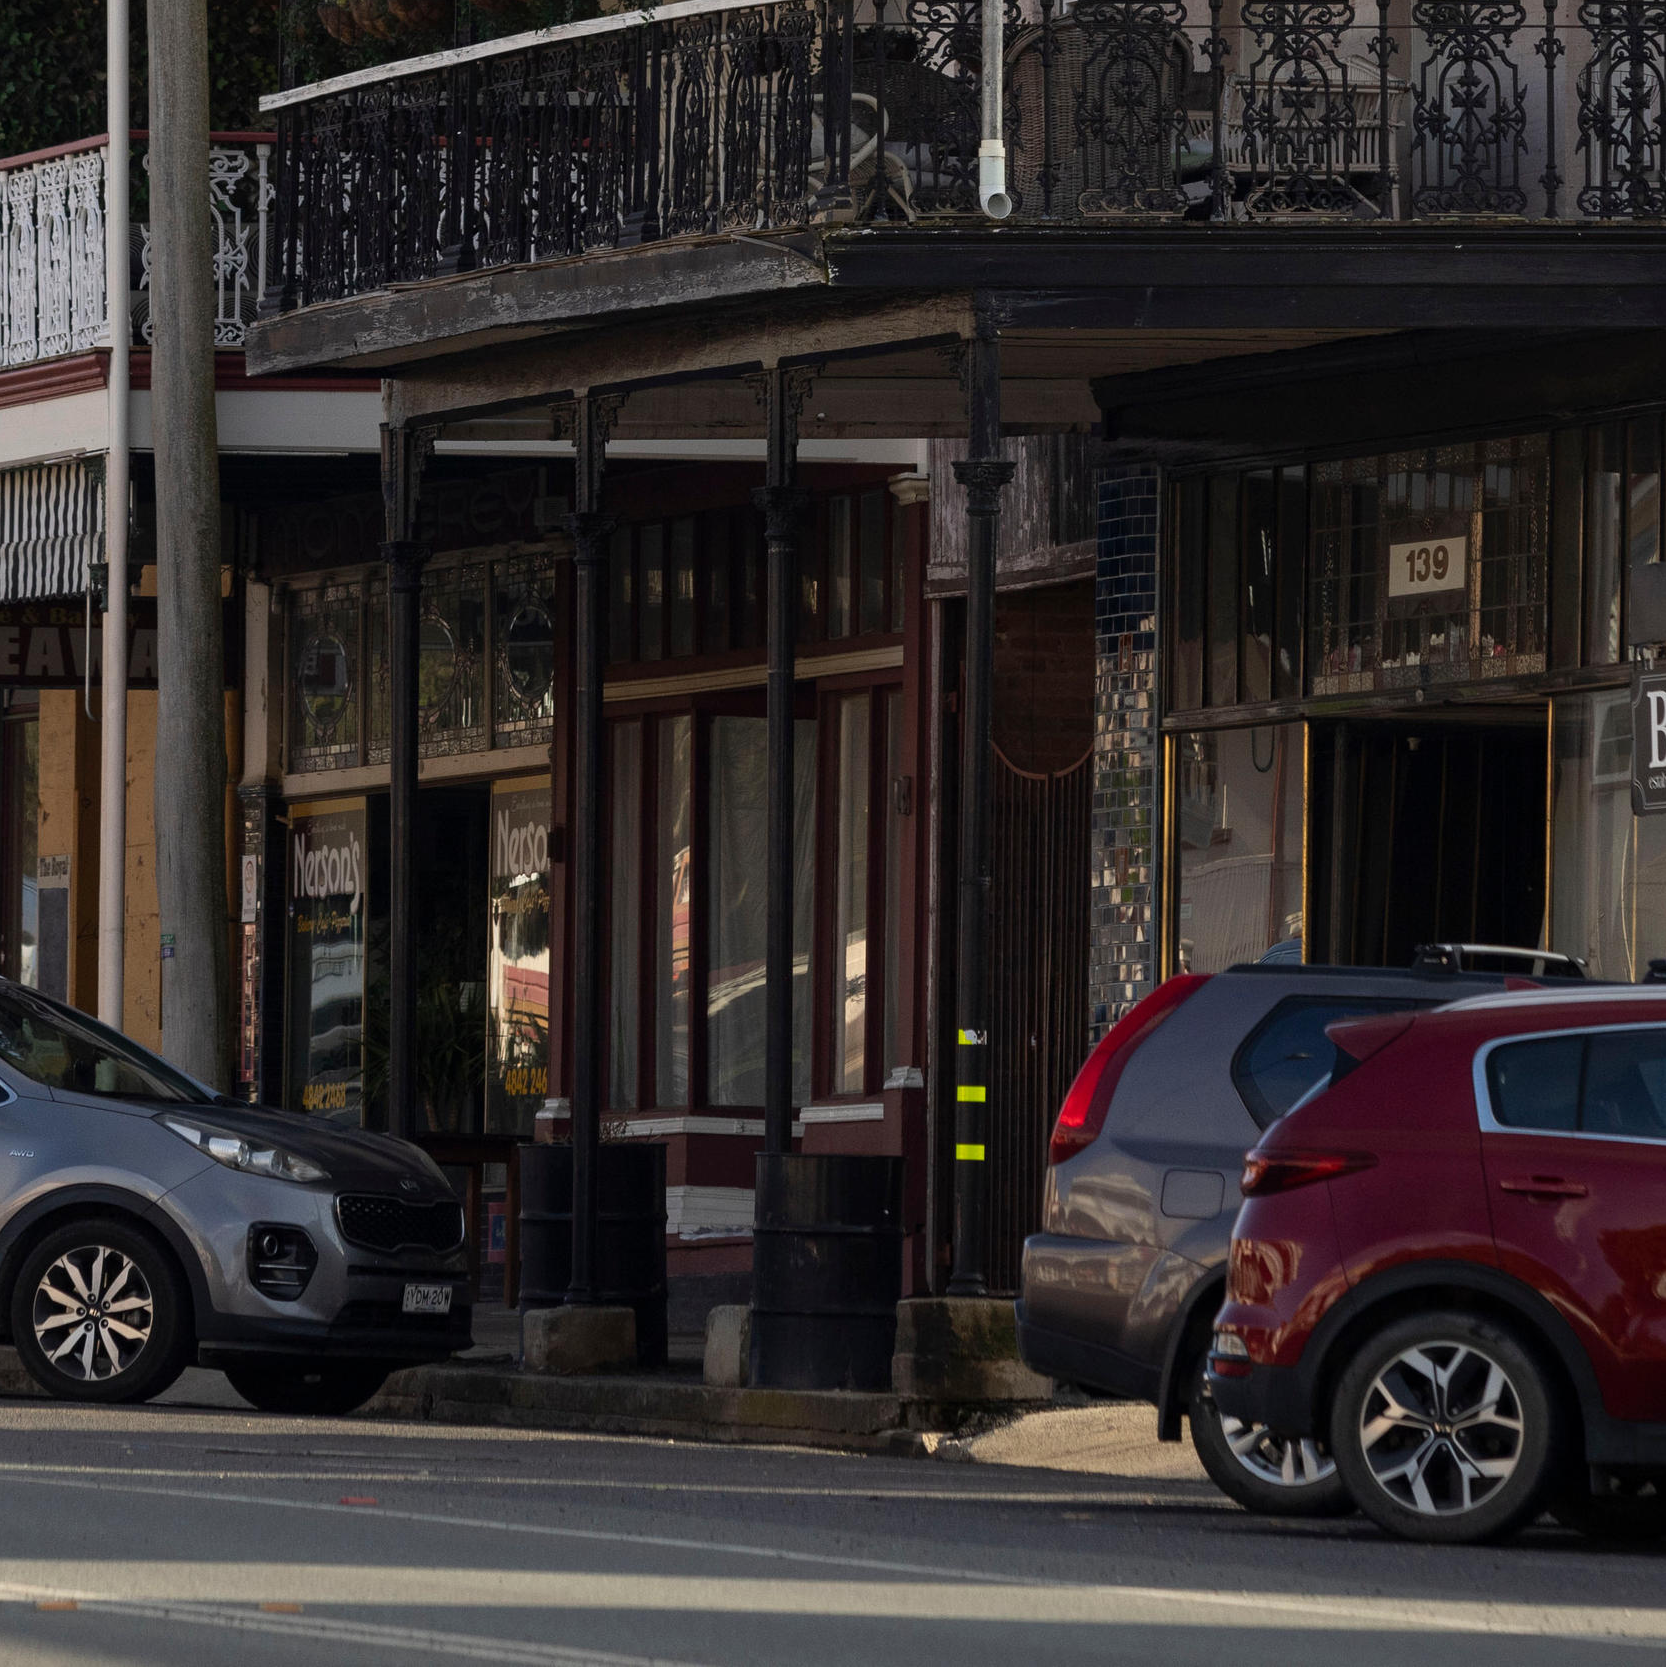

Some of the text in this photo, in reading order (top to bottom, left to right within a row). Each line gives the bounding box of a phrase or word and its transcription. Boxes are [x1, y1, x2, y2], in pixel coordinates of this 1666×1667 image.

[1406, 545, 1449, 582] 139
[497, 809, 550, 876] Nerso
[293, 831, 360, 915] Nerson's
[505, 1066, 548, 1096] 4842 246
[8, 1148, 35, 1158] AWD
